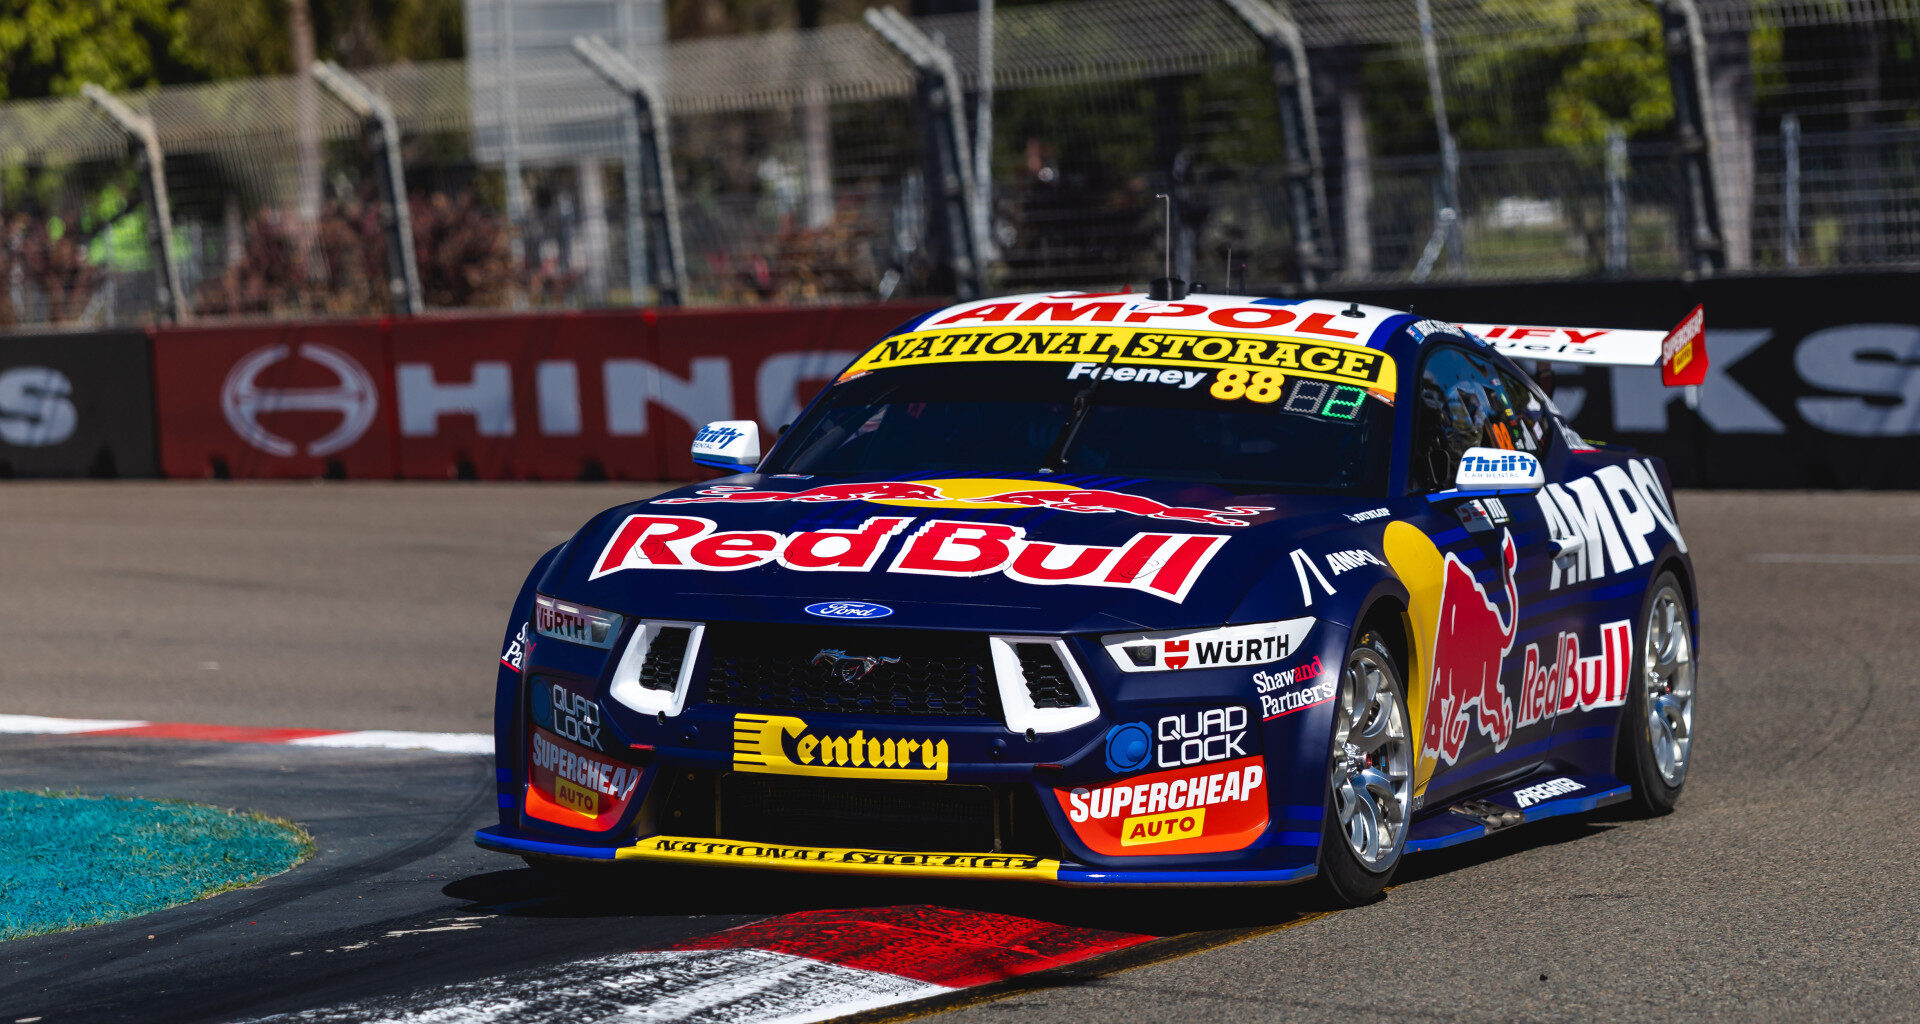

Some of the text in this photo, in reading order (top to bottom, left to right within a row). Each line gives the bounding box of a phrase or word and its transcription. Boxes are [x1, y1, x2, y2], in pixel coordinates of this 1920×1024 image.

[932, 301, 1359, 339] AMPOL
[1485, 327, 1612, 344] IFY
[868, 331, 1376, 381] NATIONAL STORAGE
[1490, 342, 1597, 355] uels
[1066, 362, 1285, 403] Feeney 88
[694, 425, 745, 449] hrifty
[1462, 455, 1537, 477] Thrifty
[1353, 507, 1391, 522] DUNLOP
[592, 515, 1228, 602] Red Bull
[819, 603, 876, 617] Ford
[1196, 634, 1289, 664] WÜRTH
[1516, 620, 1633, 728] Red Bull
[553, 684, 600, 727] QUAD
[1261, 681, 1336, 719] Partners
[554, 709, 604, 751] LOCK
[1158, 706, 1248, 741] QUAD
[736, 713, 948, 779] Century
[1158, 731, 1247, 768] LOCK
[533, 732, 640, 801] SUPERCHEAP
[559, 785, 594, 811] AUTO
[1069, 765, 1264, 823] SUPERCHEAP
[1129, 816, 1196, 840] AUTO
[655, 839, 1041, 870] NATIONAL STORAGE
